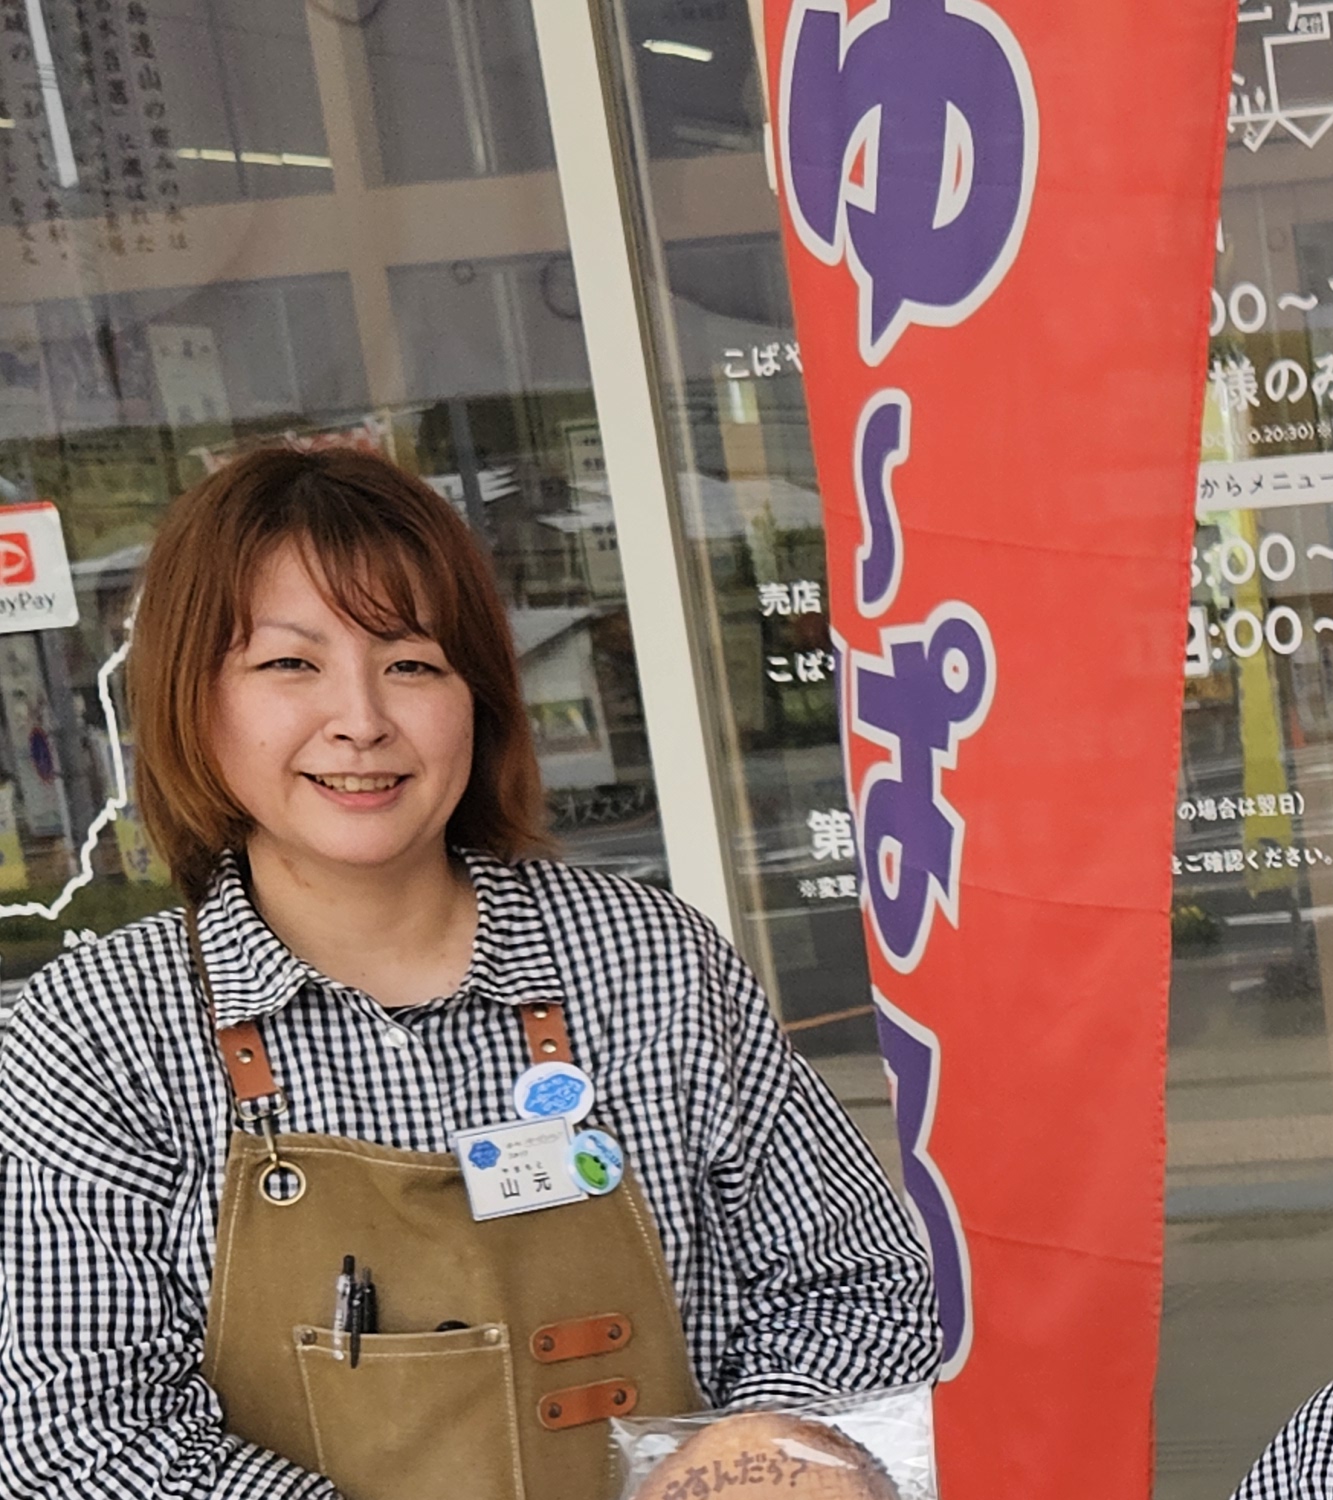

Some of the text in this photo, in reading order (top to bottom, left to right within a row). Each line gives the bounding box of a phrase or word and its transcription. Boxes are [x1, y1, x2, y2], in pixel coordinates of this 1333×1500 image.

[757, 579, 822, 617] 売店
[806, 807, 855, 861] 第
[500, 1171, 552, 1199] 山元
